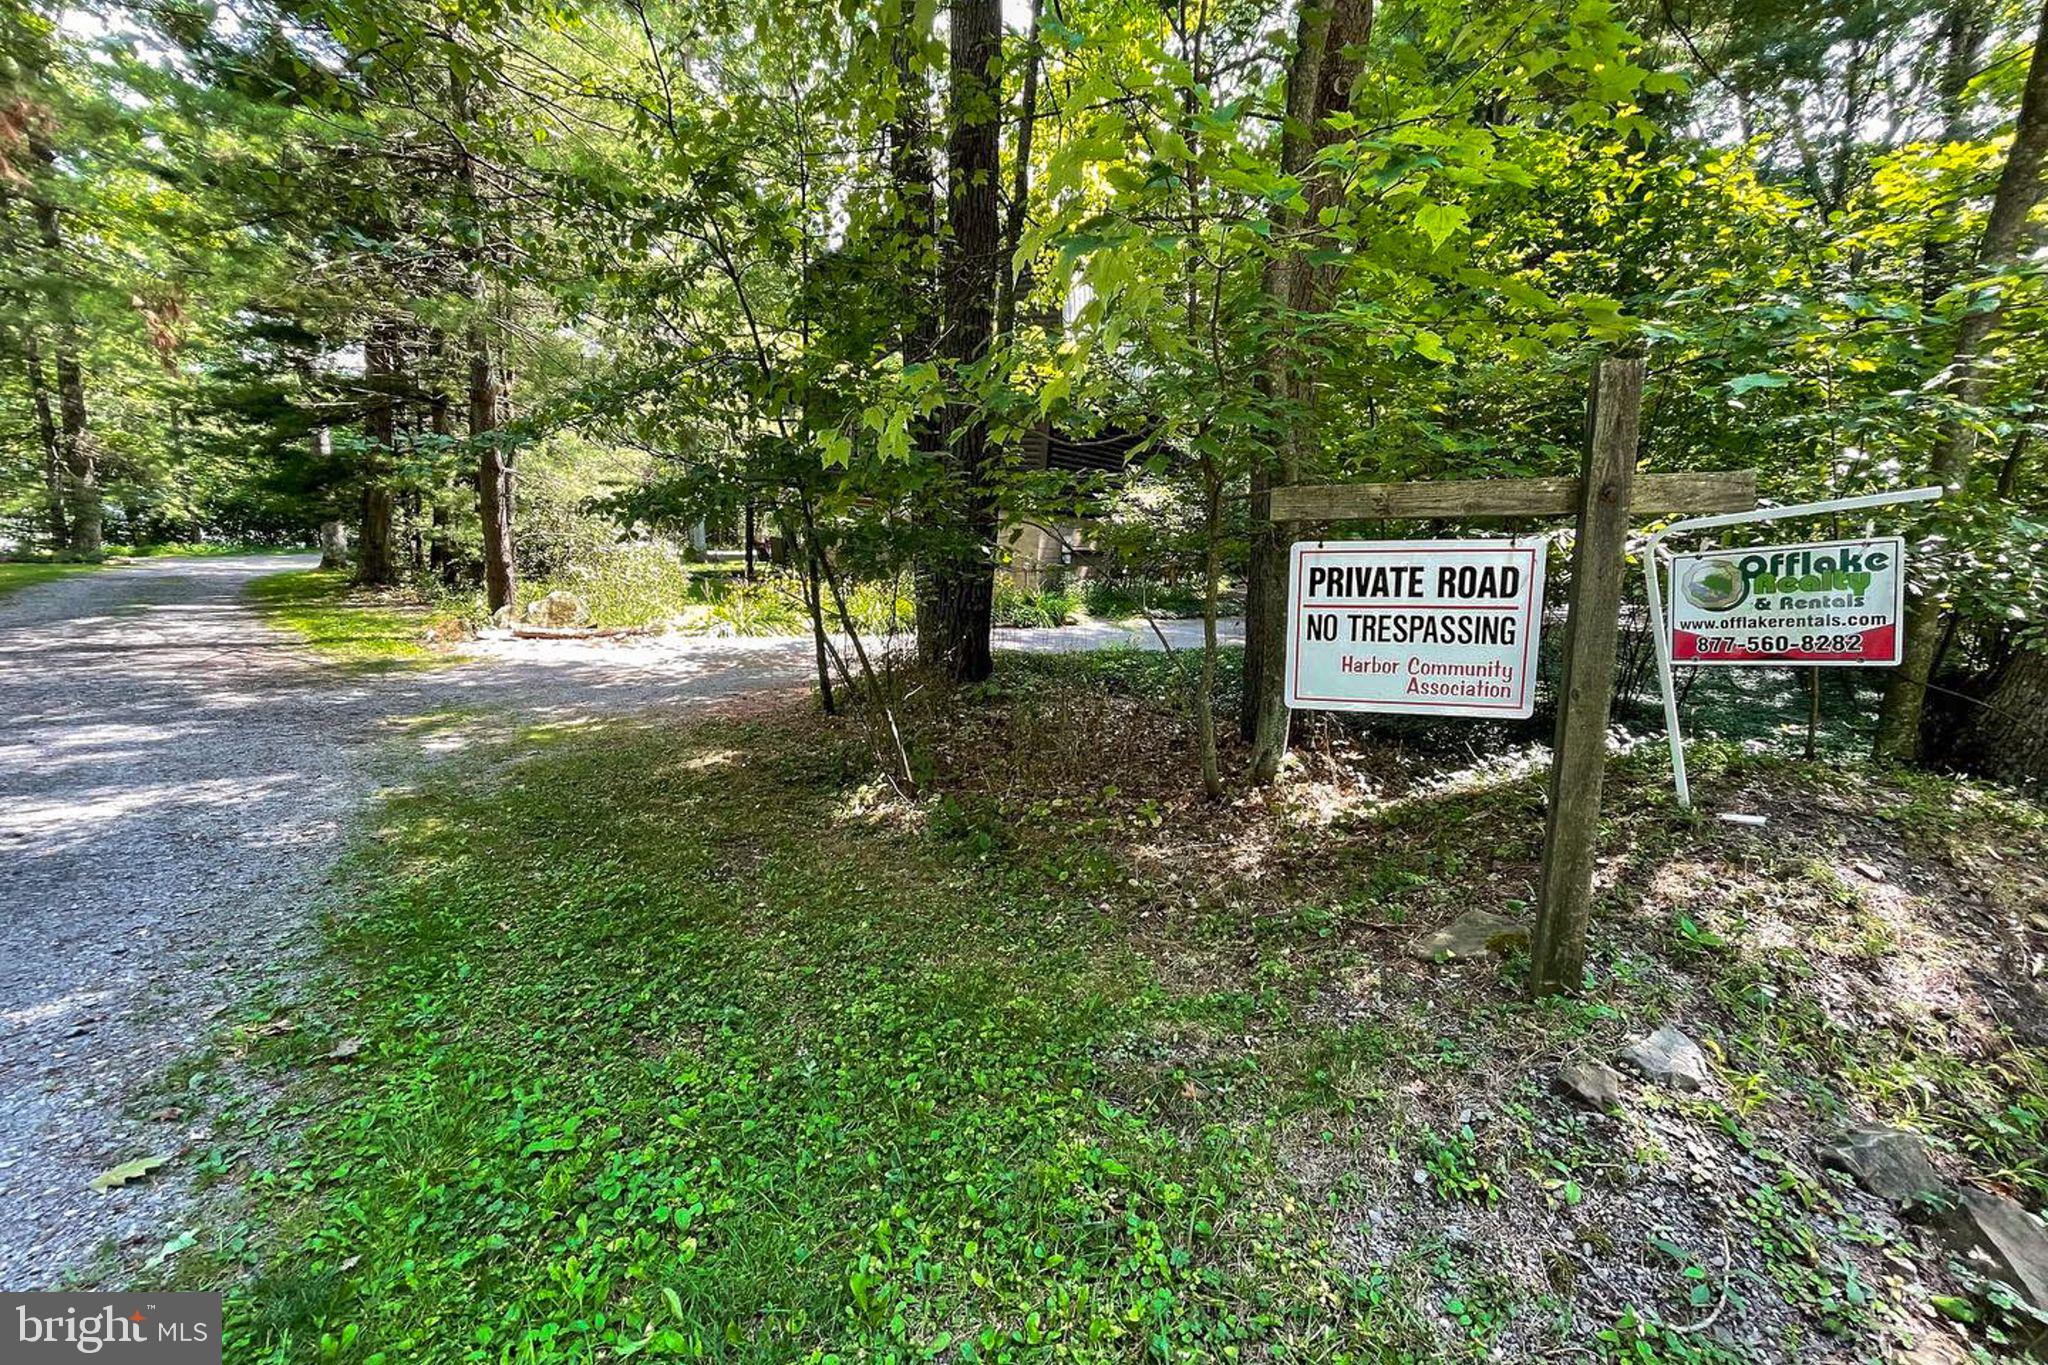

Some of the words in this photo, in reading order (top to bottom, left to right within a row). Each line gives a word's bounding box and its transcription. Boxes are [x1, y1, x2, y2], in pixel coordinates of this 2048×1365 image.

[1738, 549, 1890, 578] Offlake
[1308, 566, 1425, 598] PRIVATE
[1437, 566, 1520, 599] ROAD
[1753, 570, 1872, 595] Realty
[1754, 598, 1772, 611] &
[1779, 594, 1866, 611] Rentals
[1306, 614, 1338, 641] NO
[1347, 614, 1516, 645] TRESPASSING
[1680, 613, 1888, 630] www.offlakerentals.com
[1696, 634, 1863, 654] 877-560-8282
[1341, 656, 1400, 675] Harbor
[1407, 657, 1514, 683] Community
[1406, 677, 1512, 698] Association
